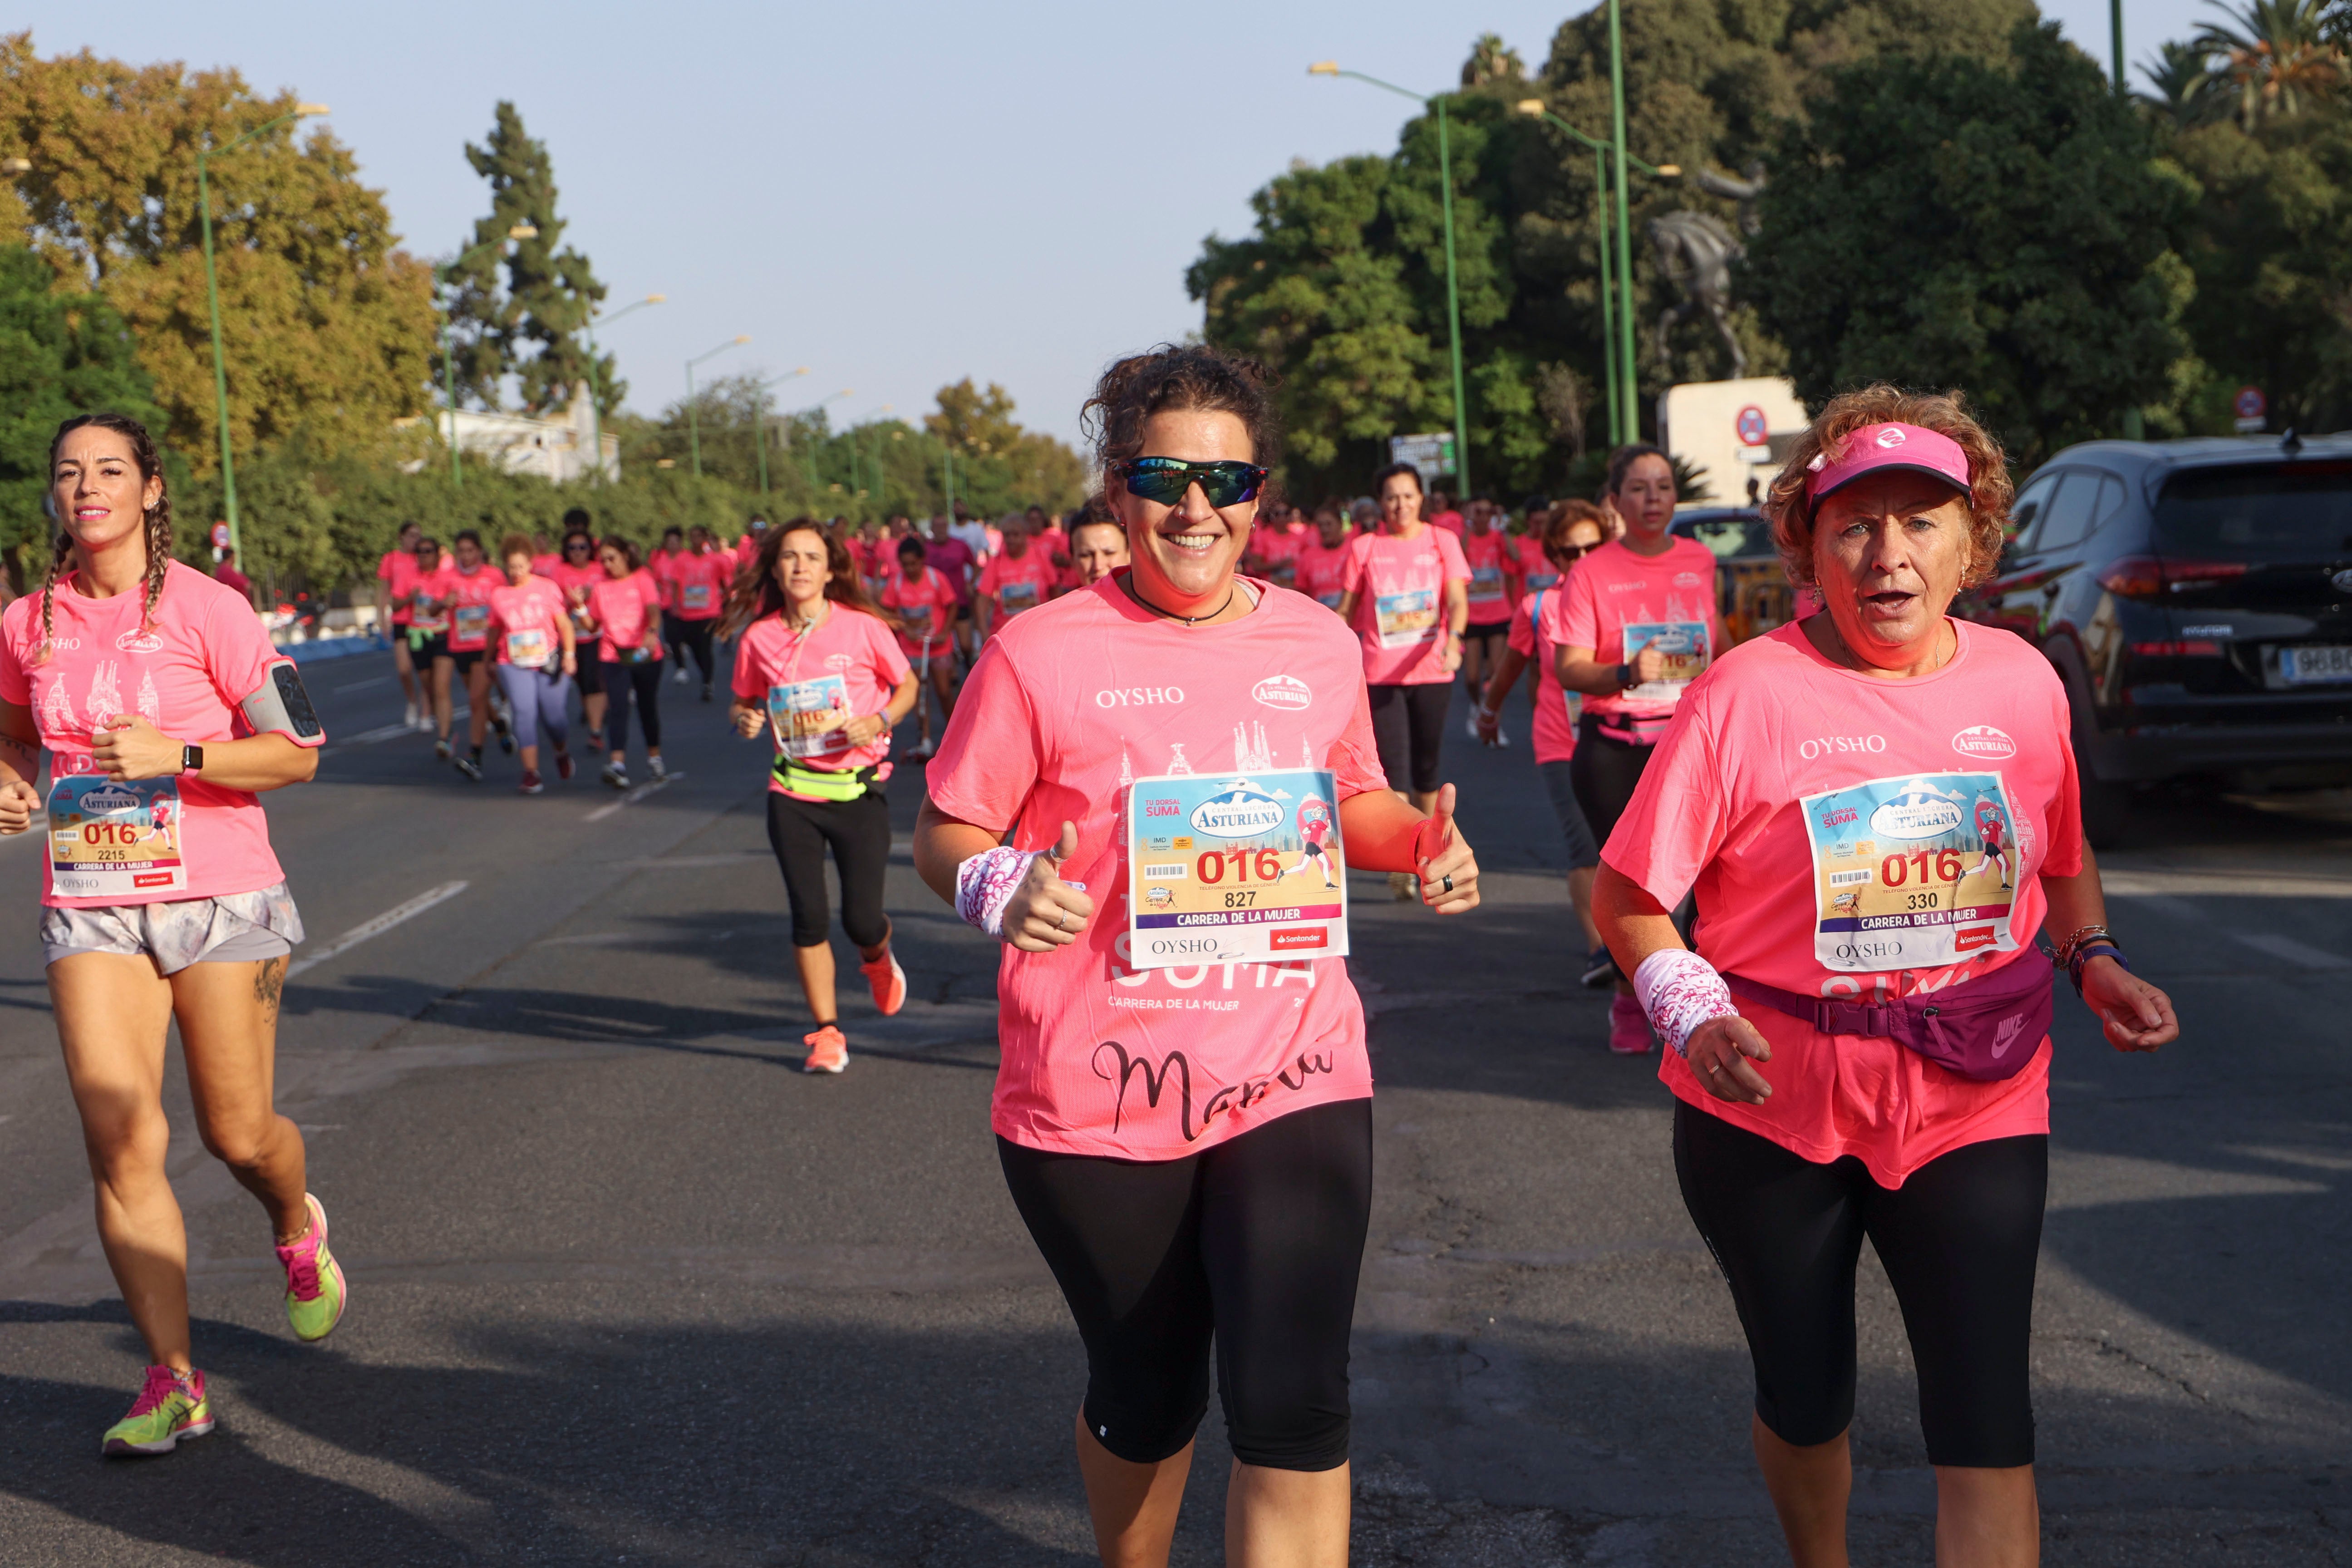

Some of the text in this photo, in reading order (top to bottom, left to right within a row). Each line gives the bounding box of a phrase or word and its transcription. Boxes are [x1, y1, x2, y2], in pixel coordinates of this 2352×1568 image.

[34, 637, 80, 650] OSHO
[1659, 653, 1687, 669] 16
[1096, 687, 1184, 708] OYSHO
[1259, 687, 1308, 704] ASTURIANA
[1800, 735, 1886, 759] OYSHO
[1959, 737, 2013, 753] ASTURIANA
[84, 797, 136, 808] ASTURIANA
[1146, 806, 1181, 817] SUMA
[1197, 810, 1279, 828] ASTURIANA
[1831, 806, 1857, 816] DORSAL
[1890, 807, 1921, 816] CENTRAL
[1823, 812, 1859, 829] SUMA
[1879, 811, 1958, 831] ASTURIANA
[84, 823, 136, 844] 016
[98, 850, 125, 860] 2215
[105, 862, 114, 870] DE
[127, 861, 153, 869] MUJER
[1197, 847, 1281, 884] 016
[1881, 848, 1963, 887] 016
[63, 878, 98, 888] OYSHO
[1156, 901, 1169, 909] Mujer
[1225, 891, 1256, 908] 827
[1908, 892, 1938, 910] 330
[1177, 909, 1300, 926] CARRERA DE LA MUJER
[1861, 909, 1977, 929] CARRERA DE LA MUJER
[1151, 939, 1218, 954] OYSHO
[1286, 934, 1320, 943] Santander
[1964, 934, 1988, 943] Santander
[1836, 941, 1902, 958] OYSHO
[1108, 996, 1239, 1011] CARRERA DE LA MUJER
[1996, 1013, 2023, 1042] NIKE
